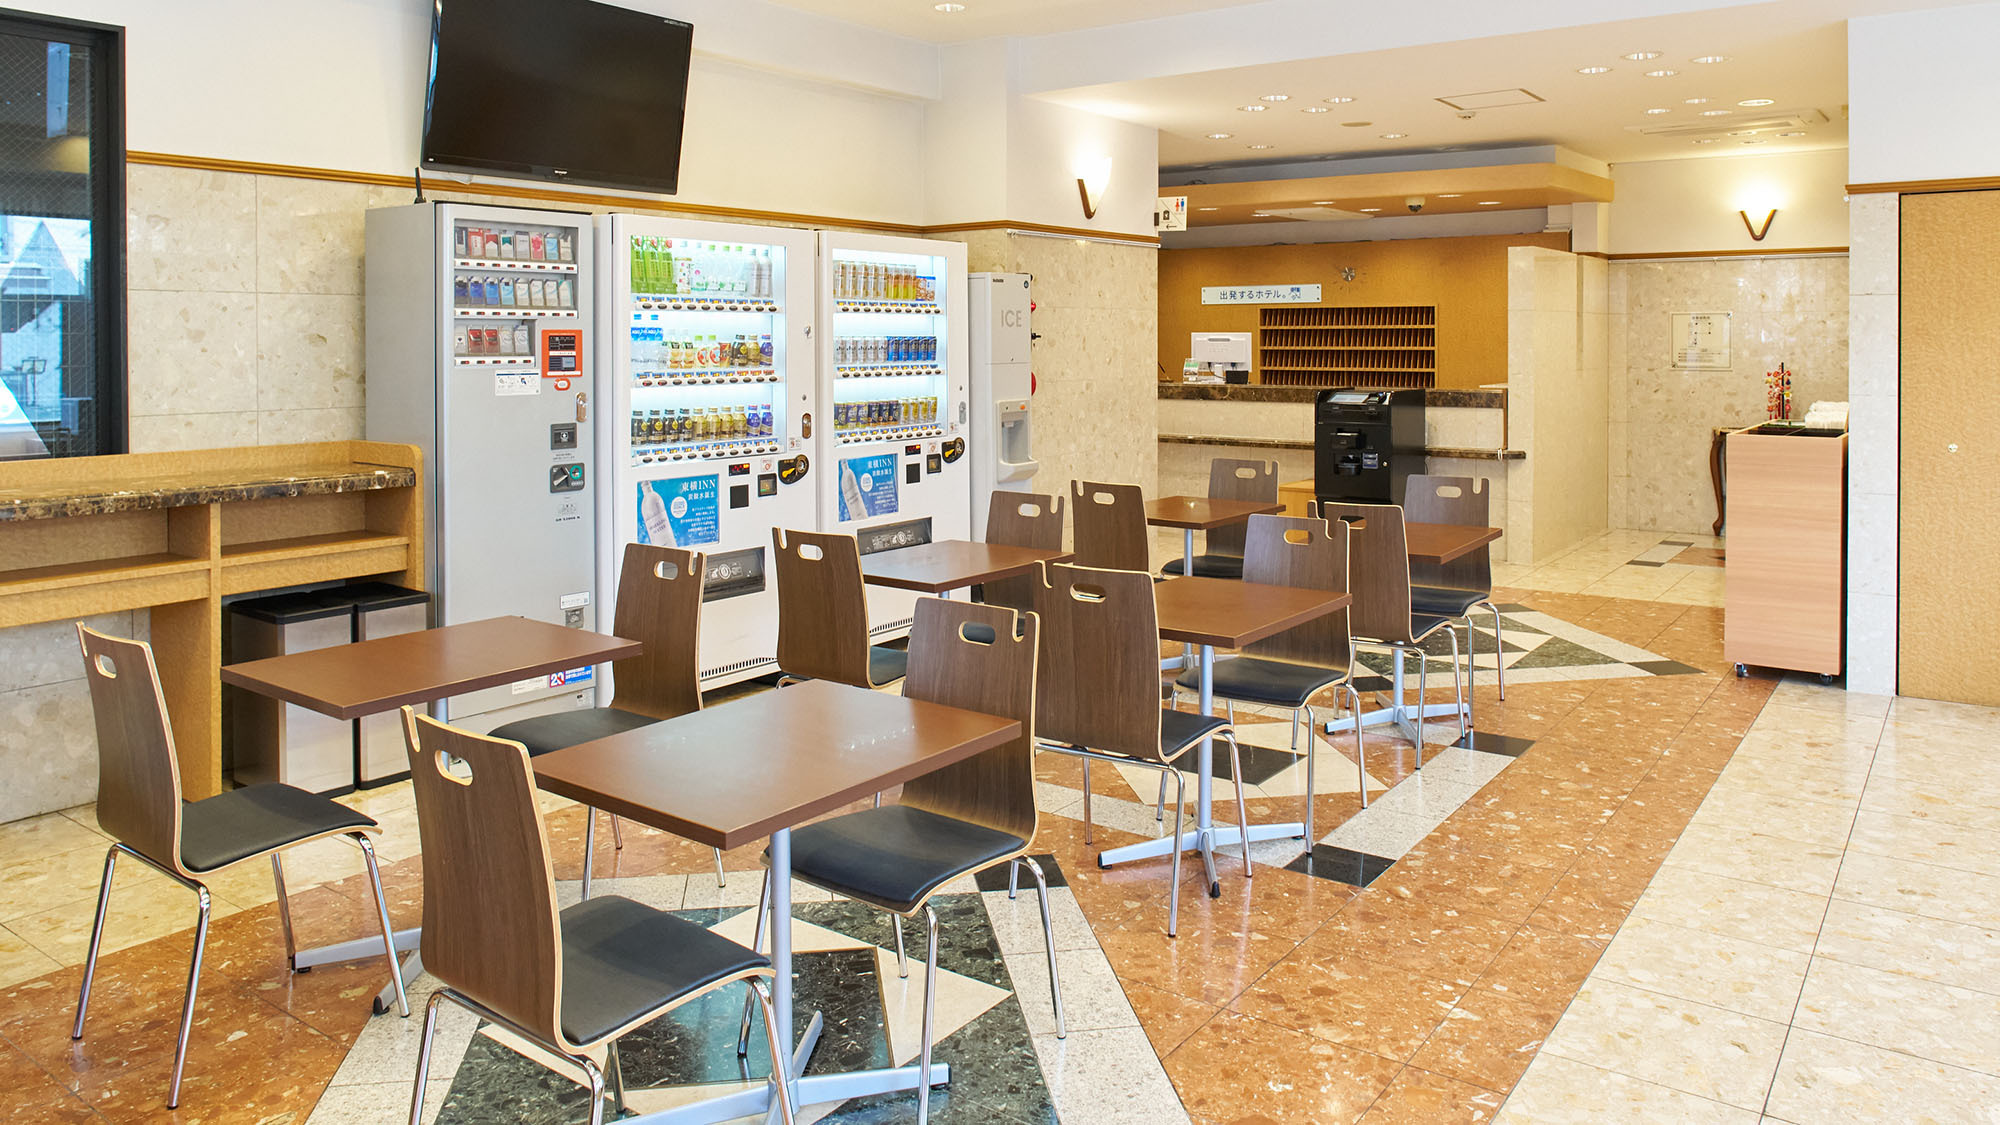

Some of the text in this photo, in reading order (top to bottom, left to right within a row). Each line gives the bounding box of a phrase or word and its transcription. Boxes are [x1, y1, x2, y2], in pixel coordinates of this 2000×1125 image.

[1219, 289, 1287, 300] 出発するホテル。
[1001, 309, 1022, 328] ICE
[681, 479, 716, 492] 東横INN
